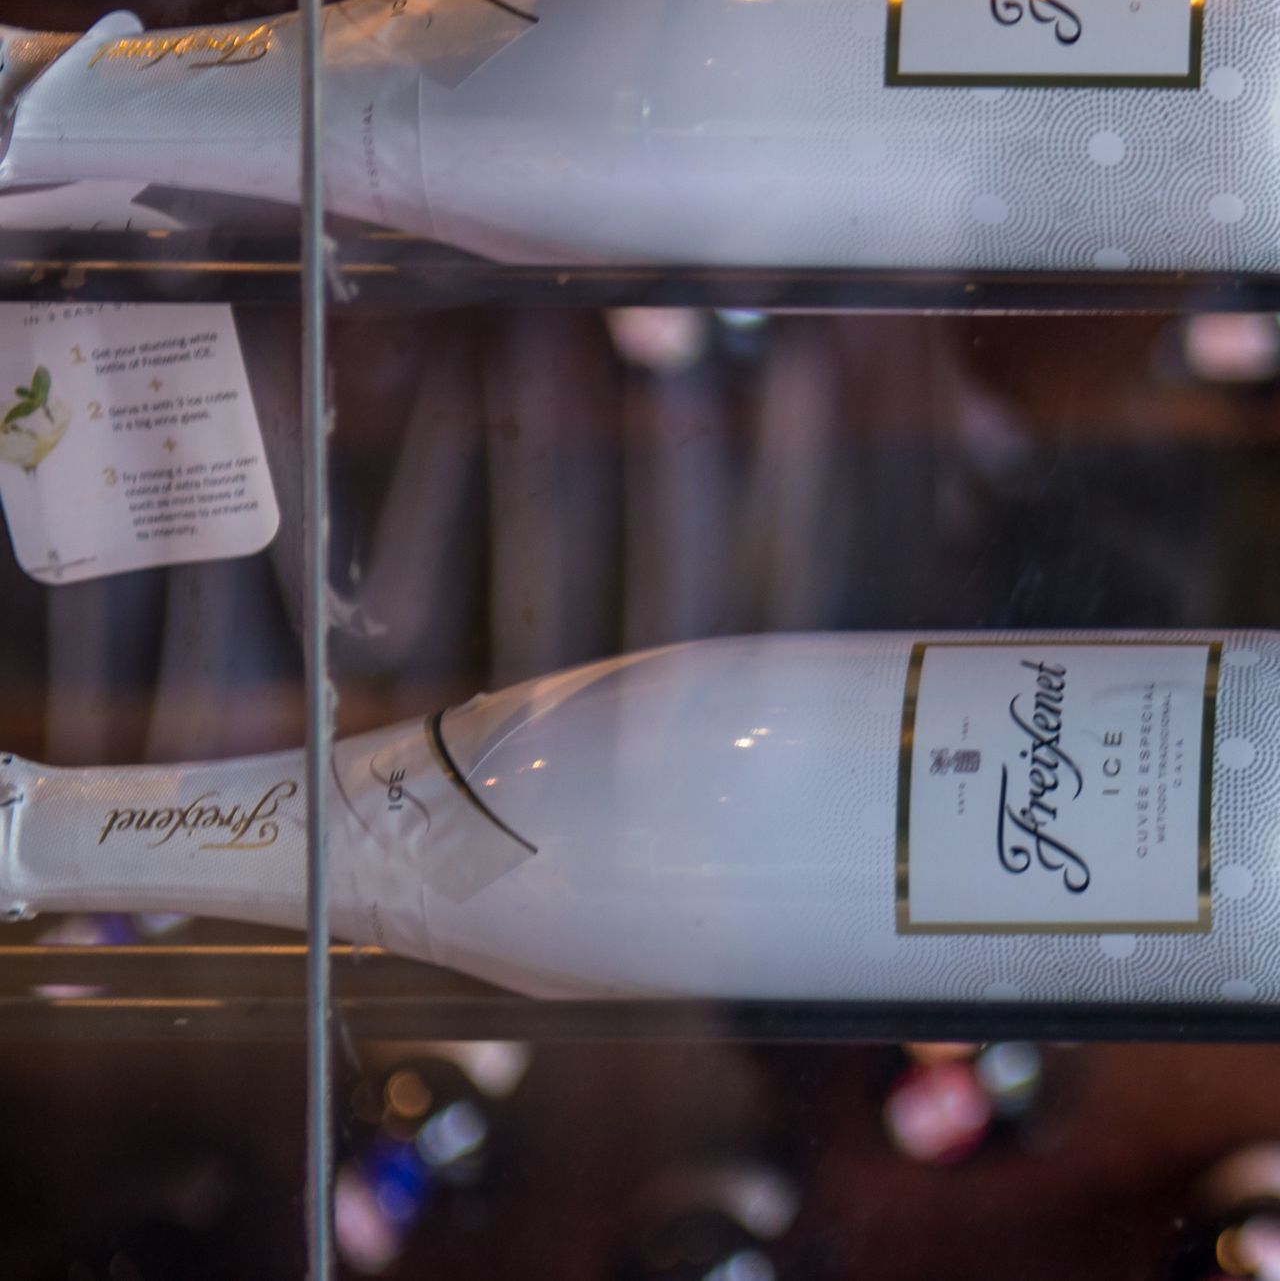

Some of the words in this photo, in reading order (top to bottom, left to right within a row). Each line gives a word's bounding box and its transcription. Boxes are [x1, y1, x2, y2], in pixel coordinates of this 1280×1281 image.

[87, 400, 104, 421] 2
[1101, 728, 1124, 796] ICE
[1138, 681, 1155, 774] ESPECIAL
[996, 659, 1092, 894] Freixenet
[1173, 737, 1185, 788] CAVA
[96, 780, 299, 850] Freixenet
